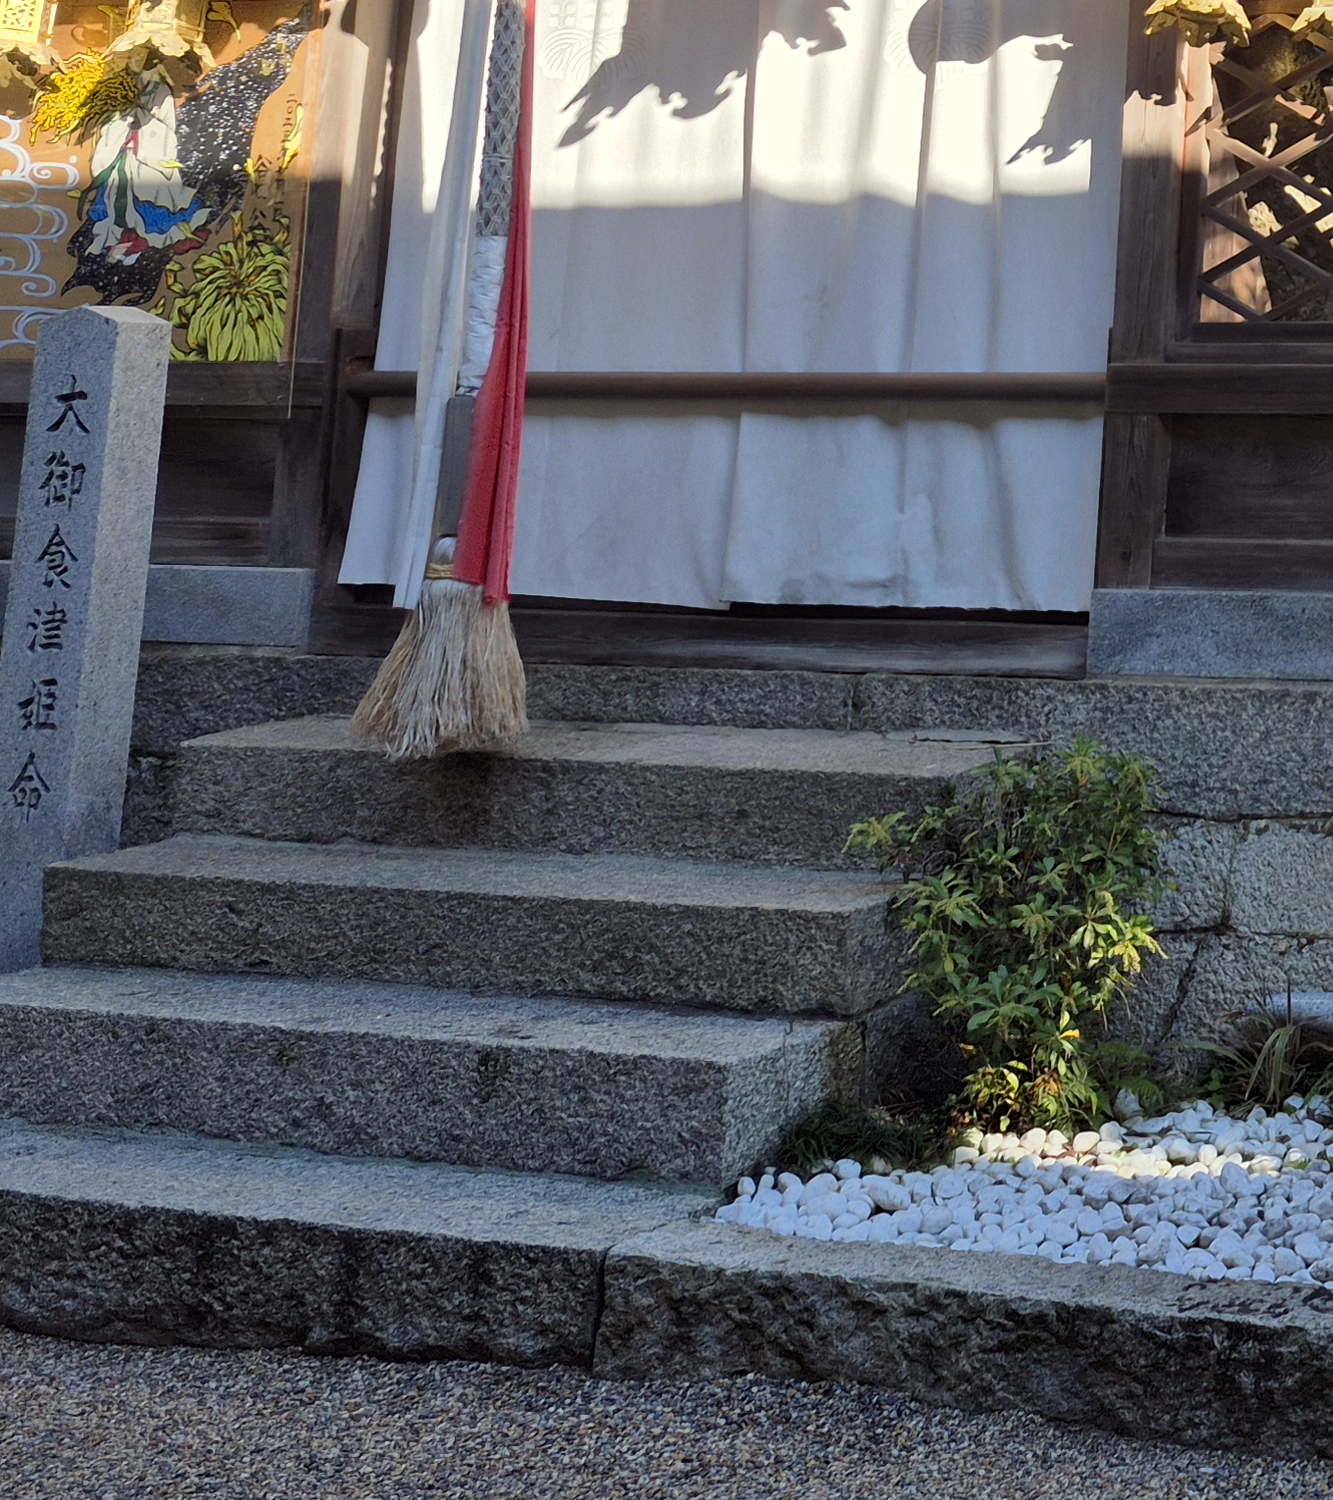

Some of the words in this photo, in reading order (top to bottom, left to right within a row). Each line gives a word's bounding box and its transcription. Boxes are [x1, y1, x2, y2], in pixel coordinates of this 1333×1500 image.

[8, 374, 91, 823] 大御食津姫命
